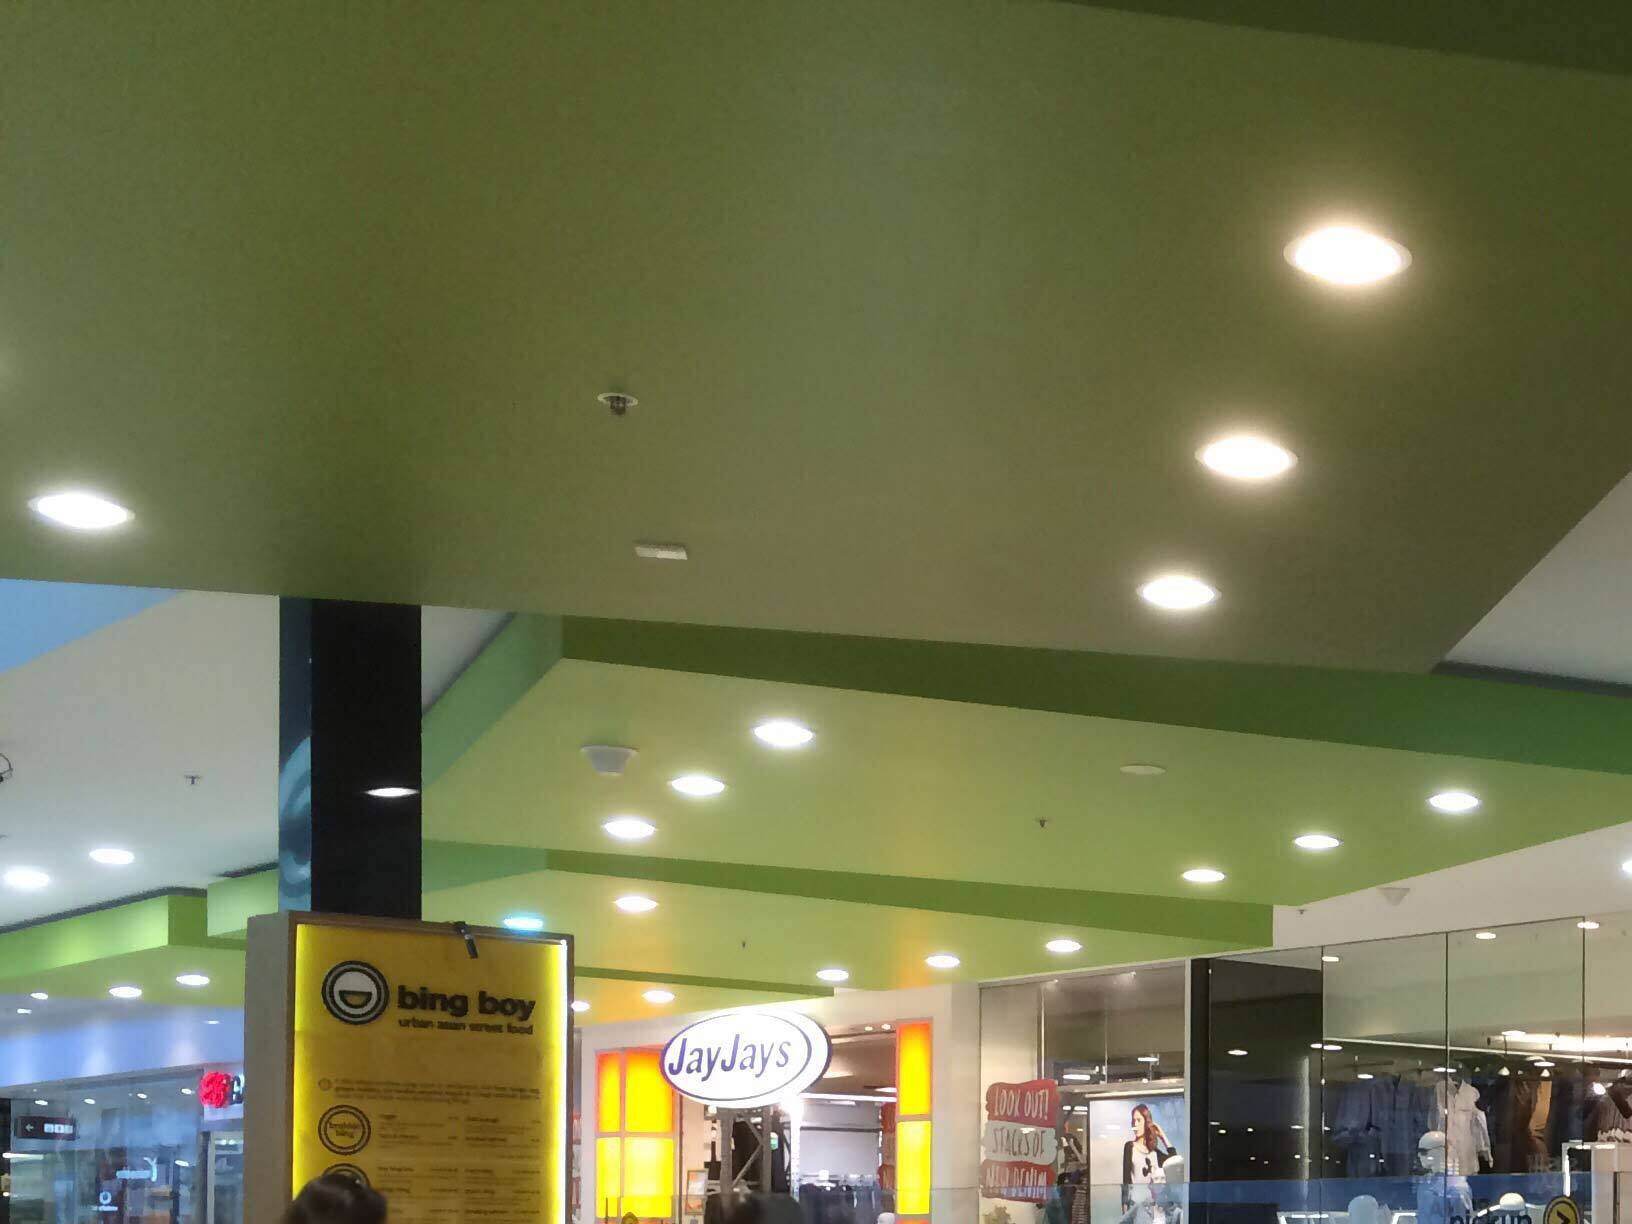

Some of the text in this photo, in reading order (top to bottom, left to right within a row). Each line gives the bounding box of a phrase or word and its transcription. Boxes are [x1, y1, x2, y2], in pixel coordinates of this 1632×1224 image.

[397, 984, 537, 1022] bing boy
[667, 1033, 792, 1083] JayJays
[993, 1086, 1050, 1121] LOOK OUT!
